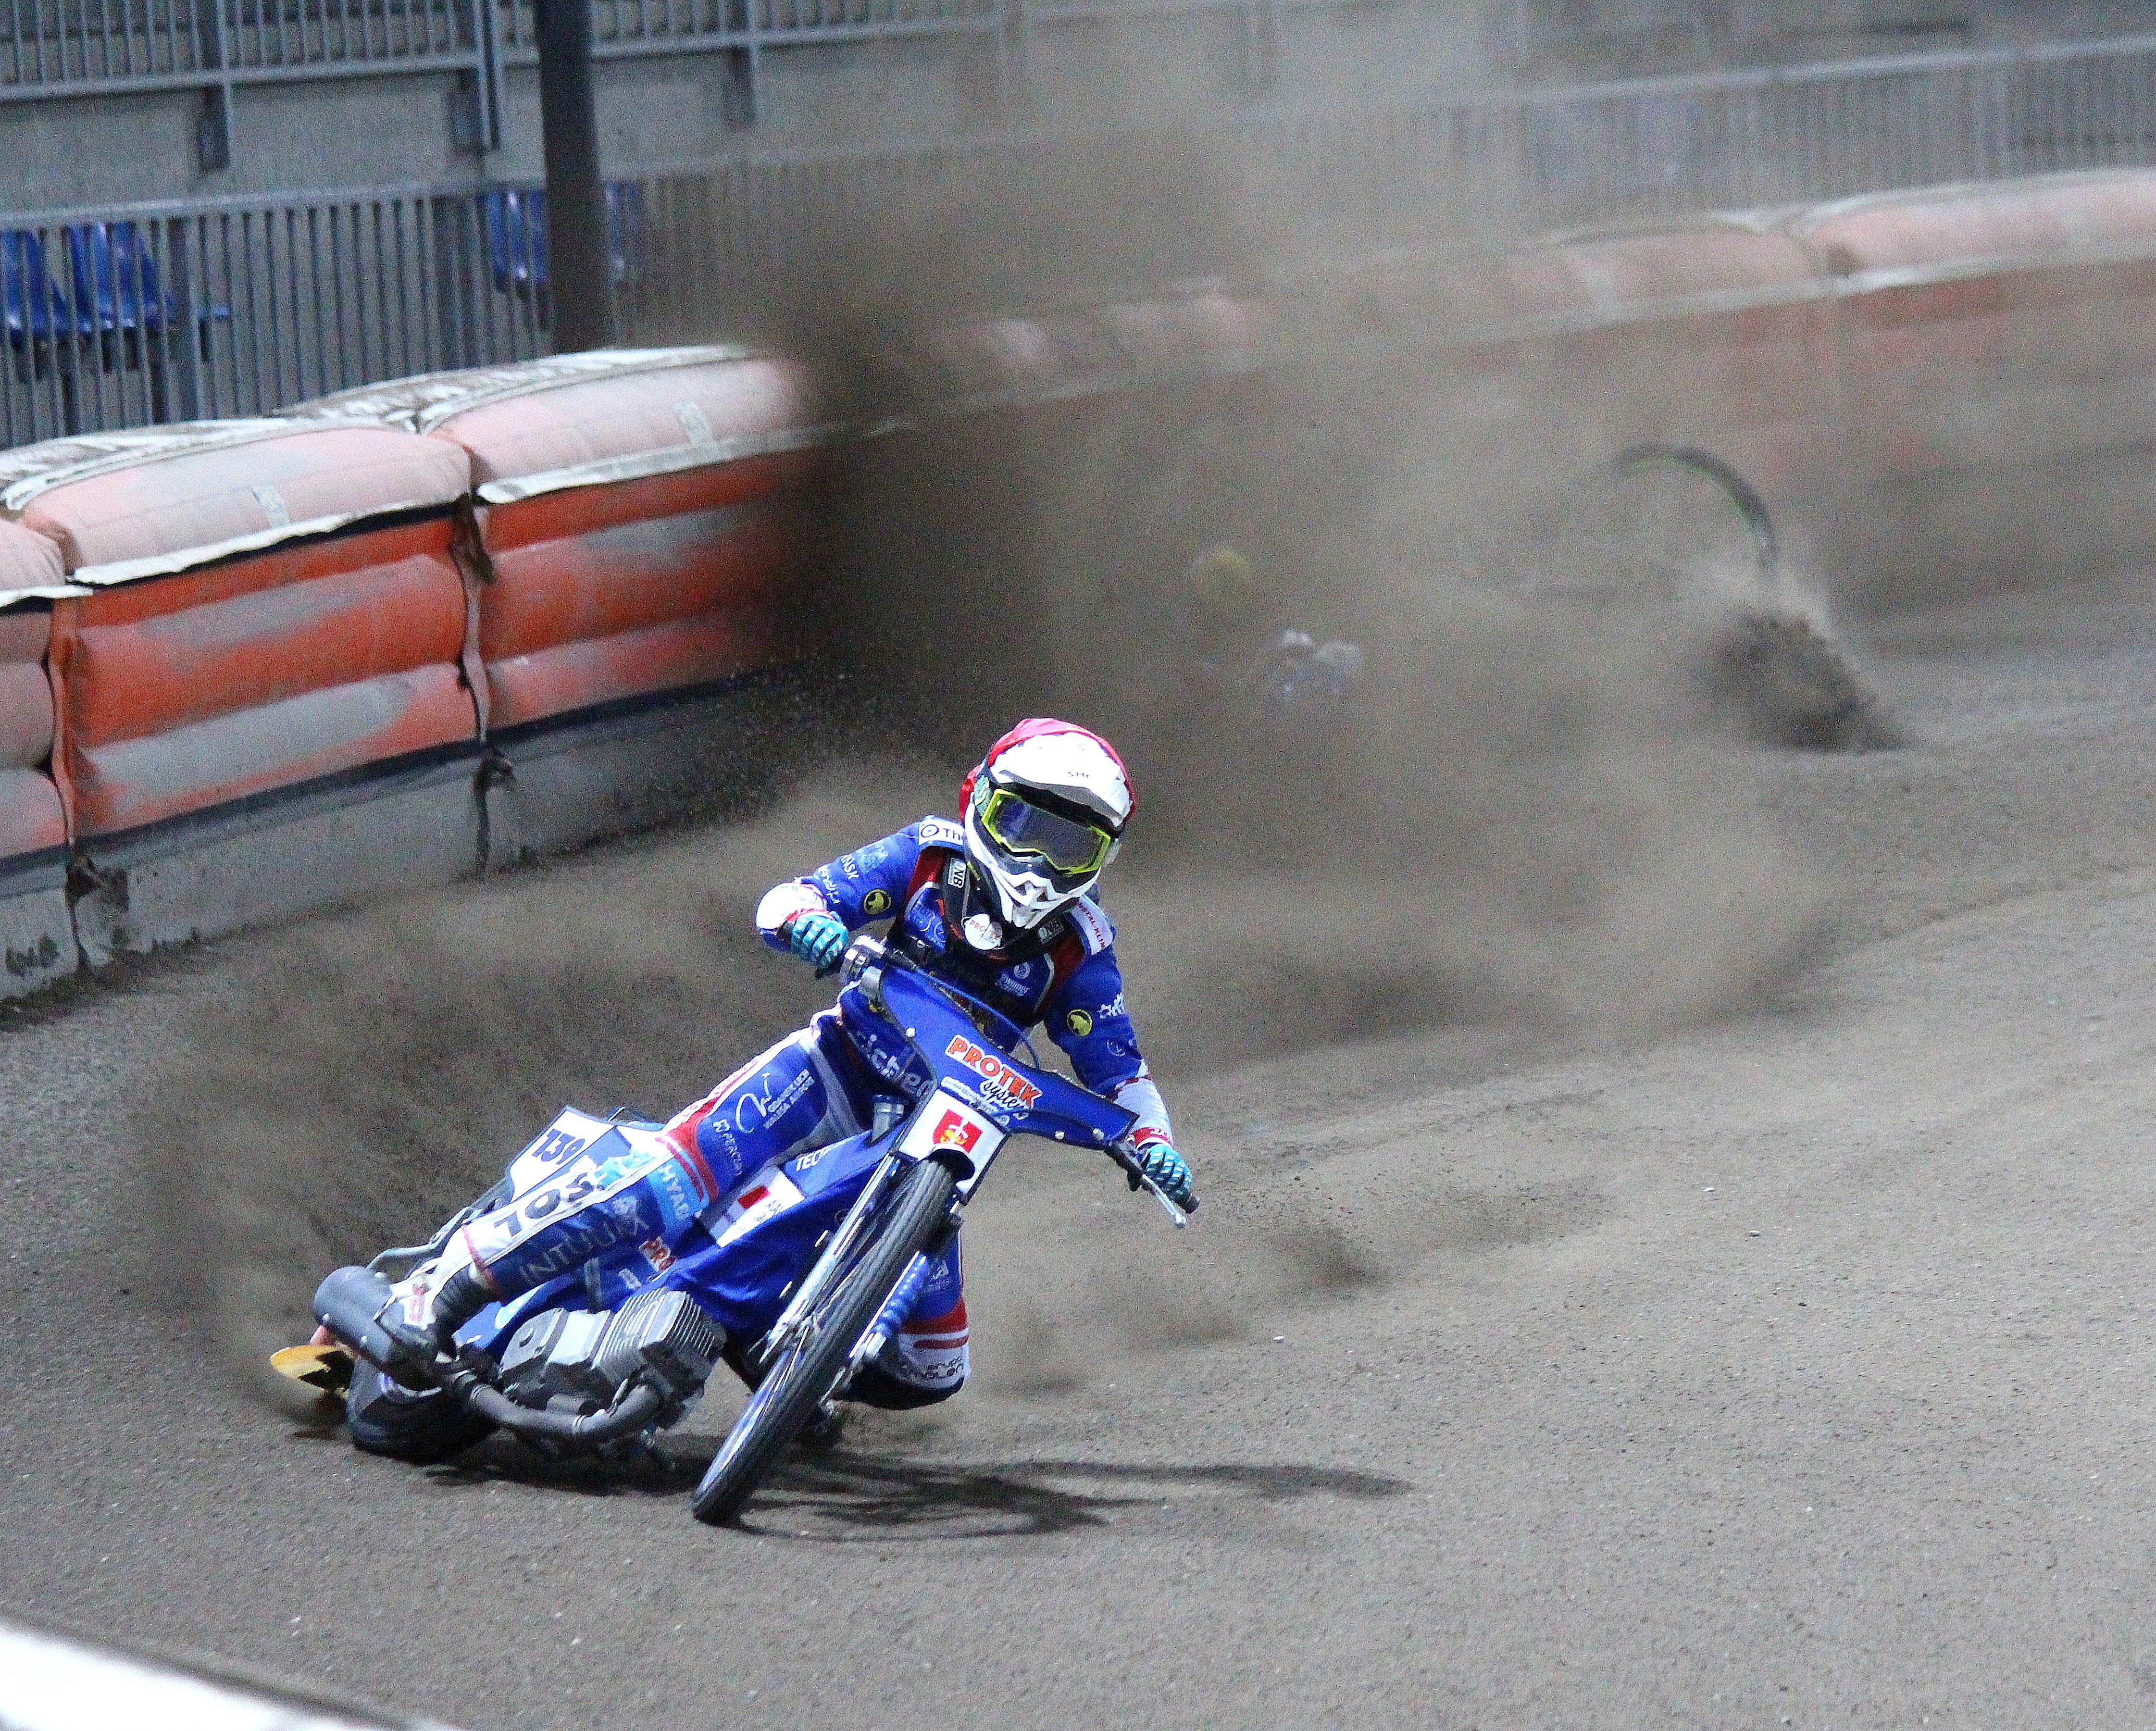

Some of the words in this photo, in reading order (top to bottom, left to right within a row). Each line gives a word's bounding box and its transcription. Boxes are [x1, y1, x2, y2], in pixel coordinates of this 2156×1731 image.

[942, 827, 964, 841] Th
[948, 1038, 1040, 1107] PROTEK
[531, 1128, 585, 1165] 139
